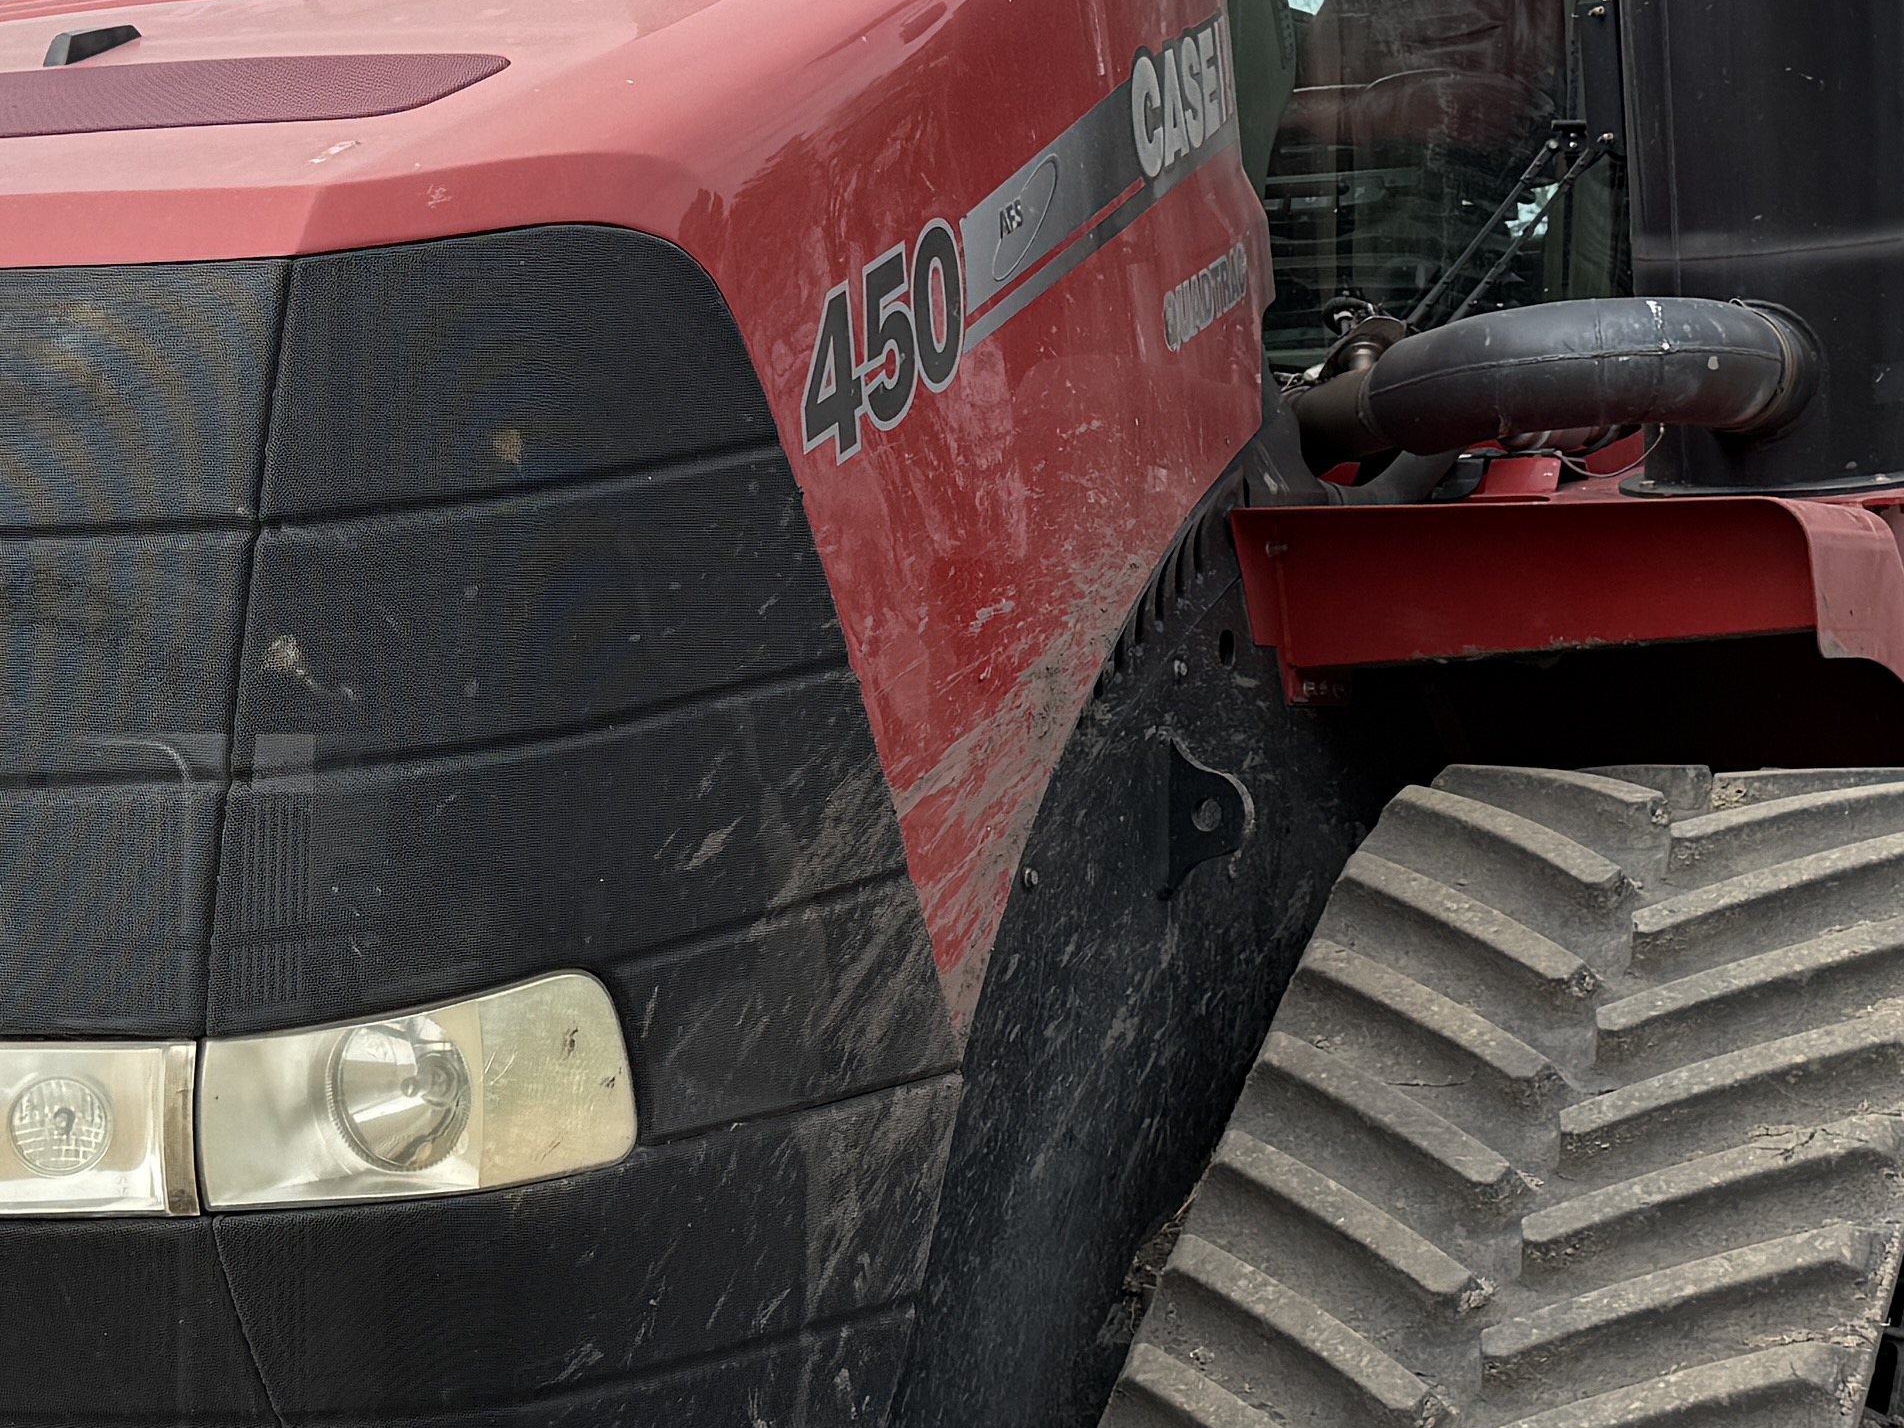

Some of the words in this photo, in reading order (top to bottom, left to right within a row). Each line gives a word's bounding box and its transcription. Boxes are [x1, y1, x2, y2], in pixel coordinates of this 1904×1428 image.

[1132, 27, 1221, 178] CASE
[999, 198, 1024, 239] AFS
[804, 217, 965, 466] 450
[1162, 242, 1247, 352] QUADTRAC
